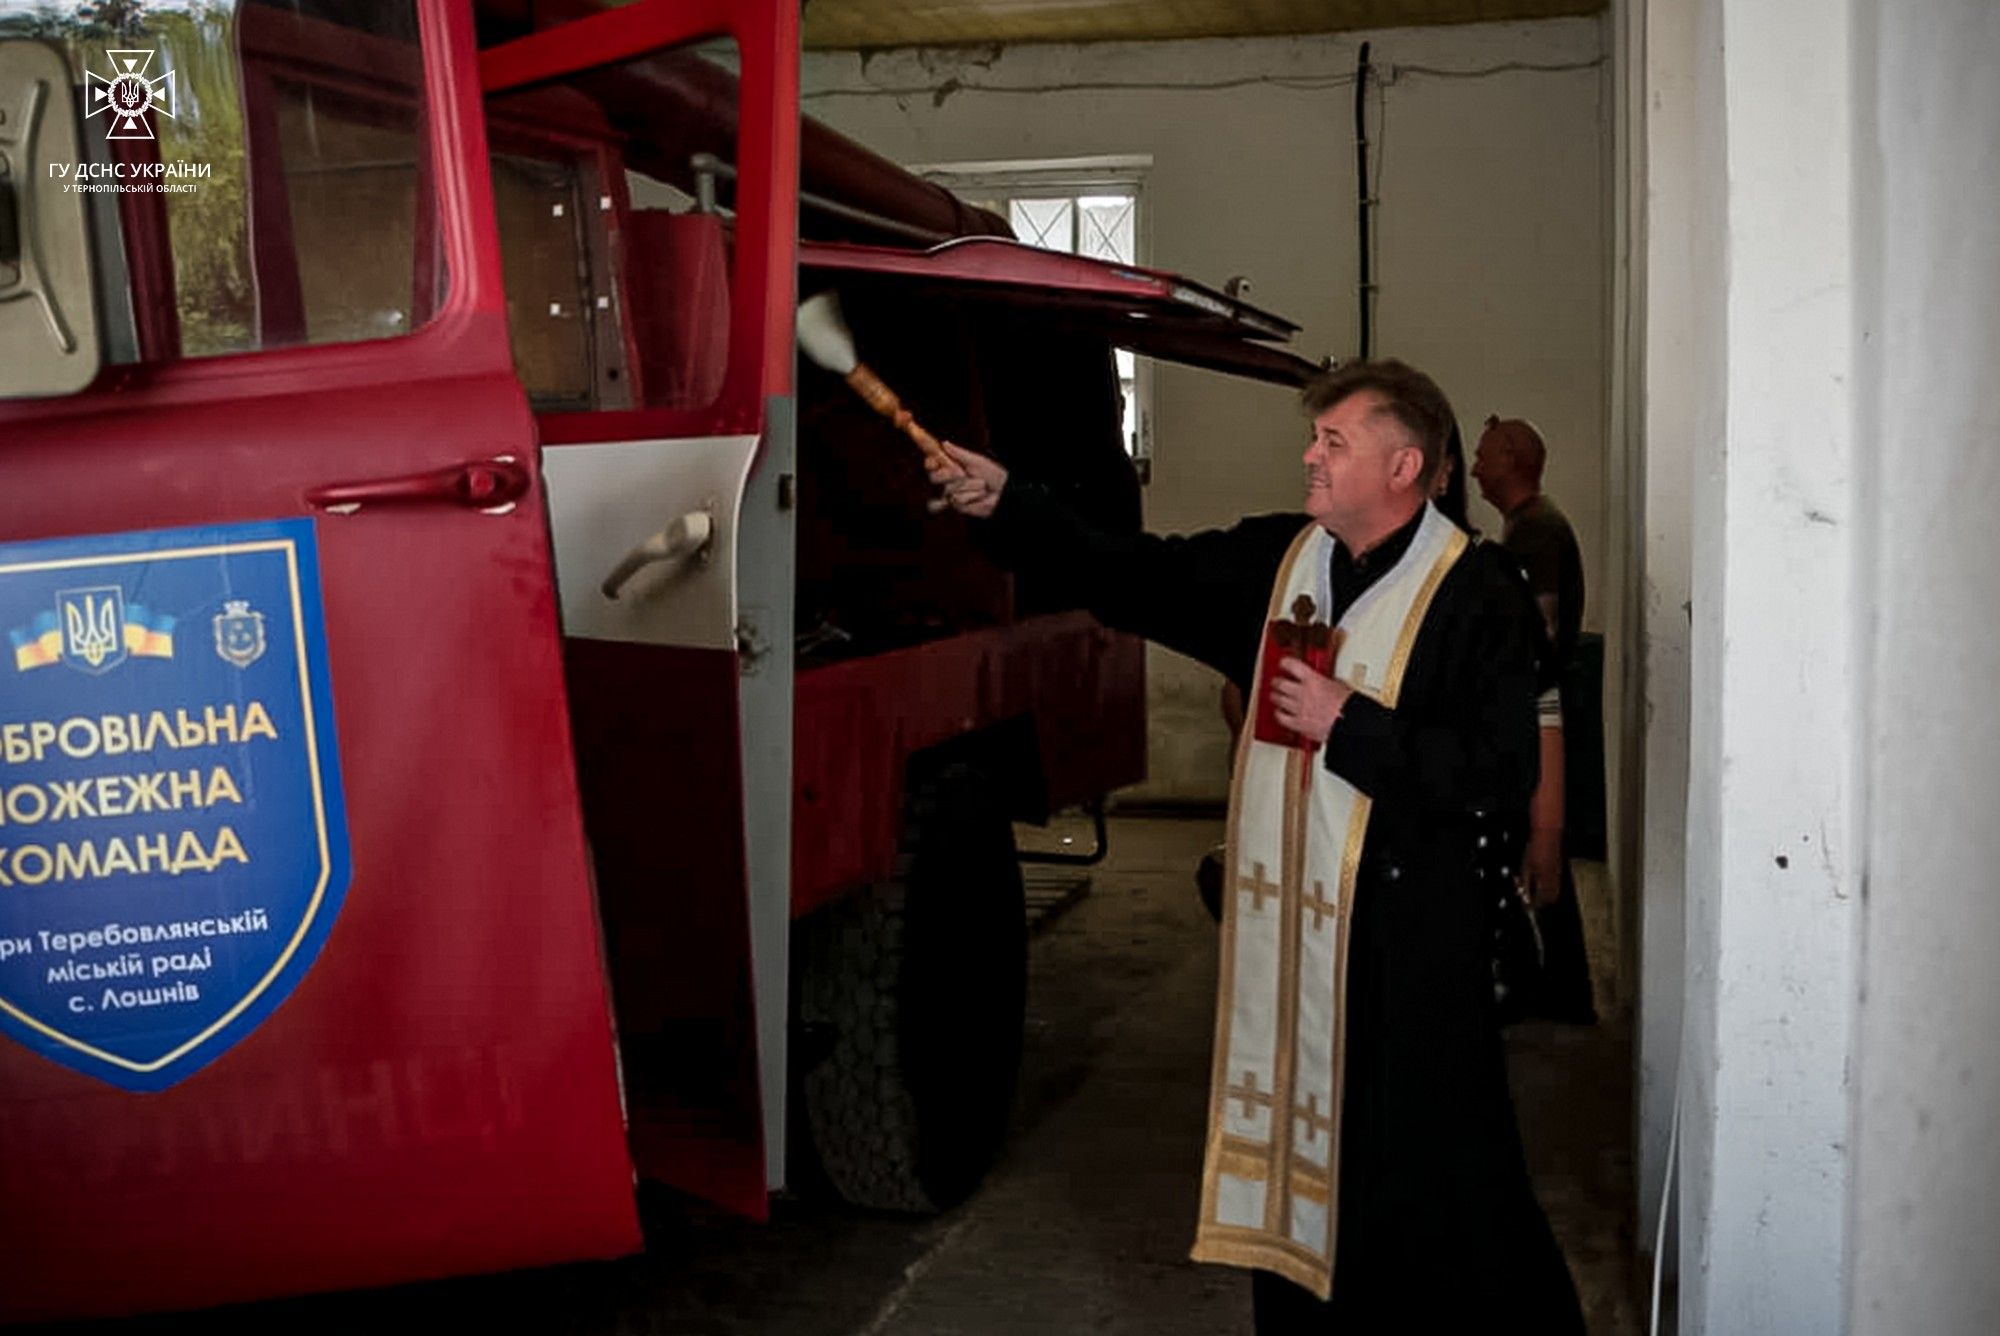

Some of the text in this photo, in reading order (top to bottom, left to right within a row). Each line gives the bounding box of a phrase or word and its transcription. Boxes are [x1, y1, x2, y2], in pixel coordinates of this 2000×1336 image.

[0, 702, 278, 764] БРОВІЛЬНА
[0, 766, 242, 826] ОЖЕЖНА
[38, 908, 269, 954] Теребовлянській
[47, 946, 212, 984] міській раді
[68, 981, 200, 1013] с. Лошнів
